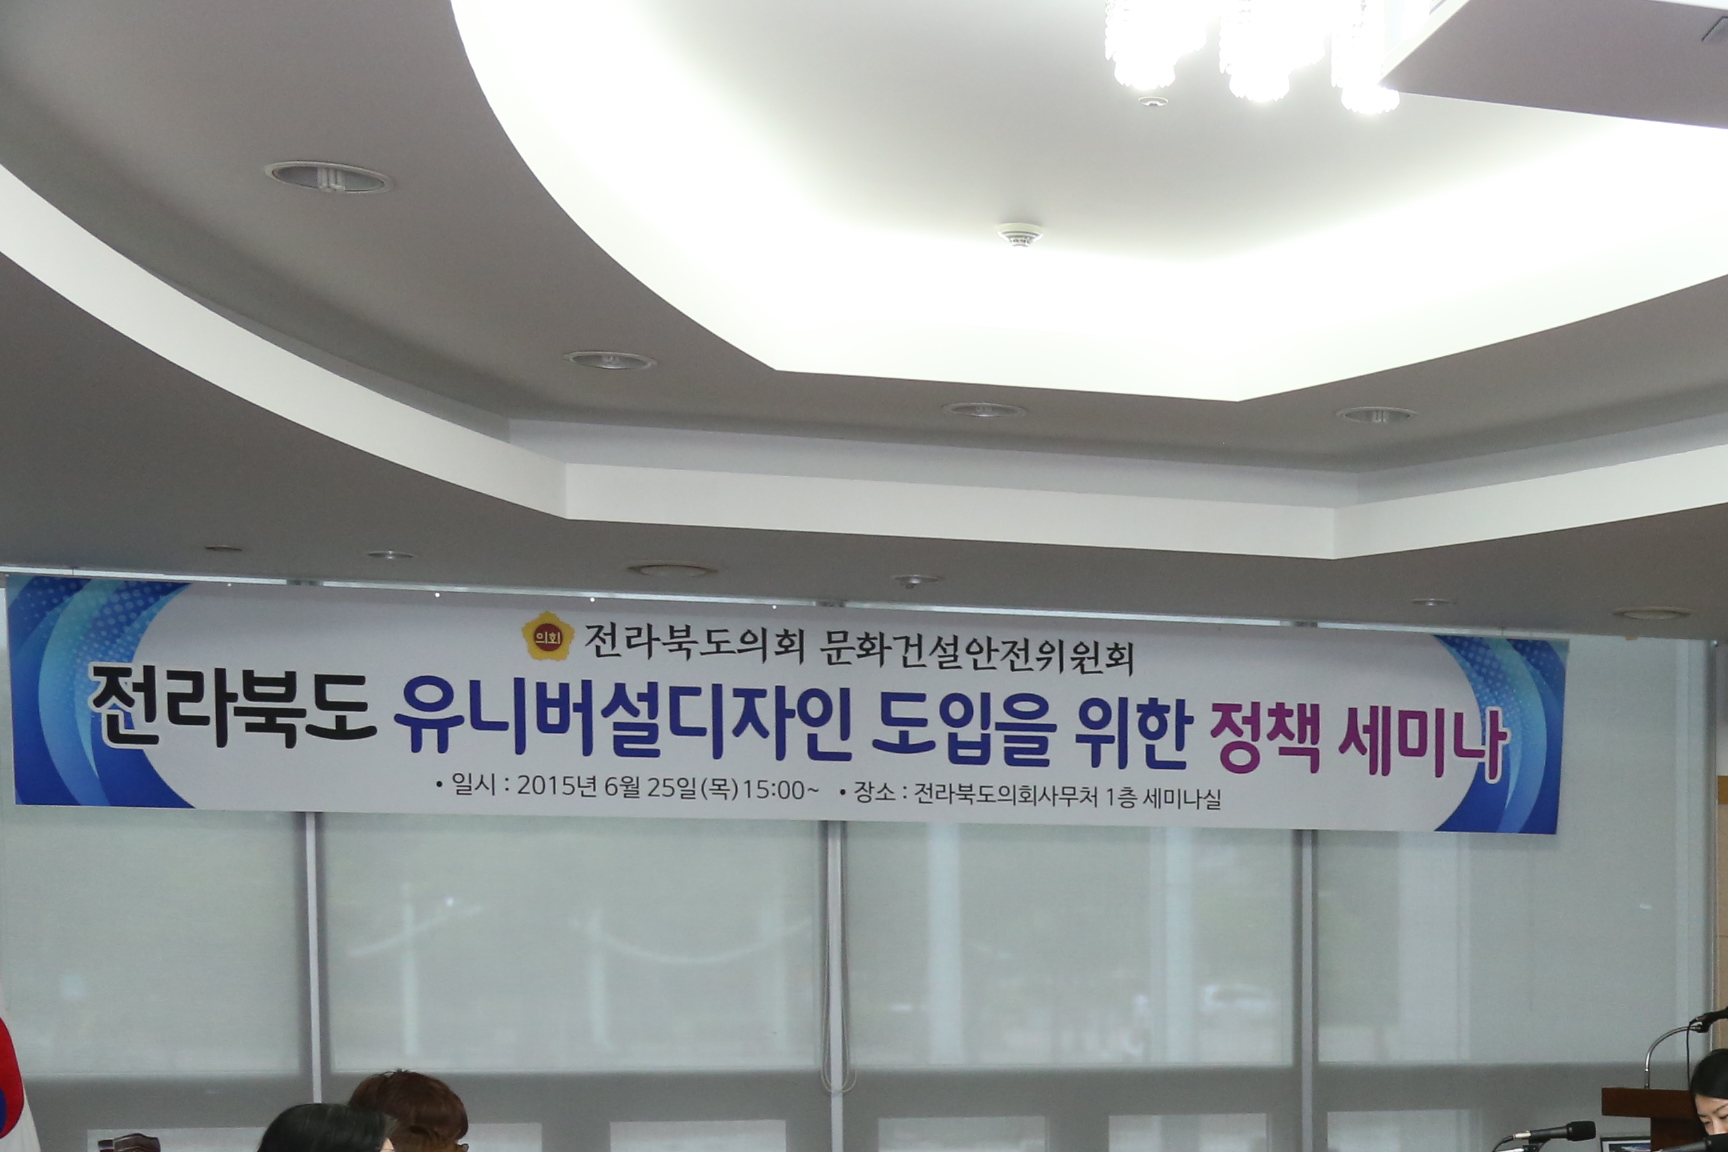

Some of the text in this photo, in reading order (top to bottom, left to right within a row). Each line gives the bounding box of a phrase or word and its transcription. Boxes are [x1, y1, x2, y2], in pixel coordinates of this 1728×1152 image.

[535, 631, 561, 645] 의회
[586, 622, 1134, 677] 전라북도의회 문화건설안전위원회
[91, 663, 1508, 779] 전라북도 유니버설디자인 도입을 위한 정책 세미나
[518, 775, 597, 798] 2015년
[605, 776, 641, 799] 6월
[915, 783, 1097, 808] 전라북도의회사무처
[1107, 787, 1138, 809] 1층
[1143, 788, 1221, 811] 세미나실
